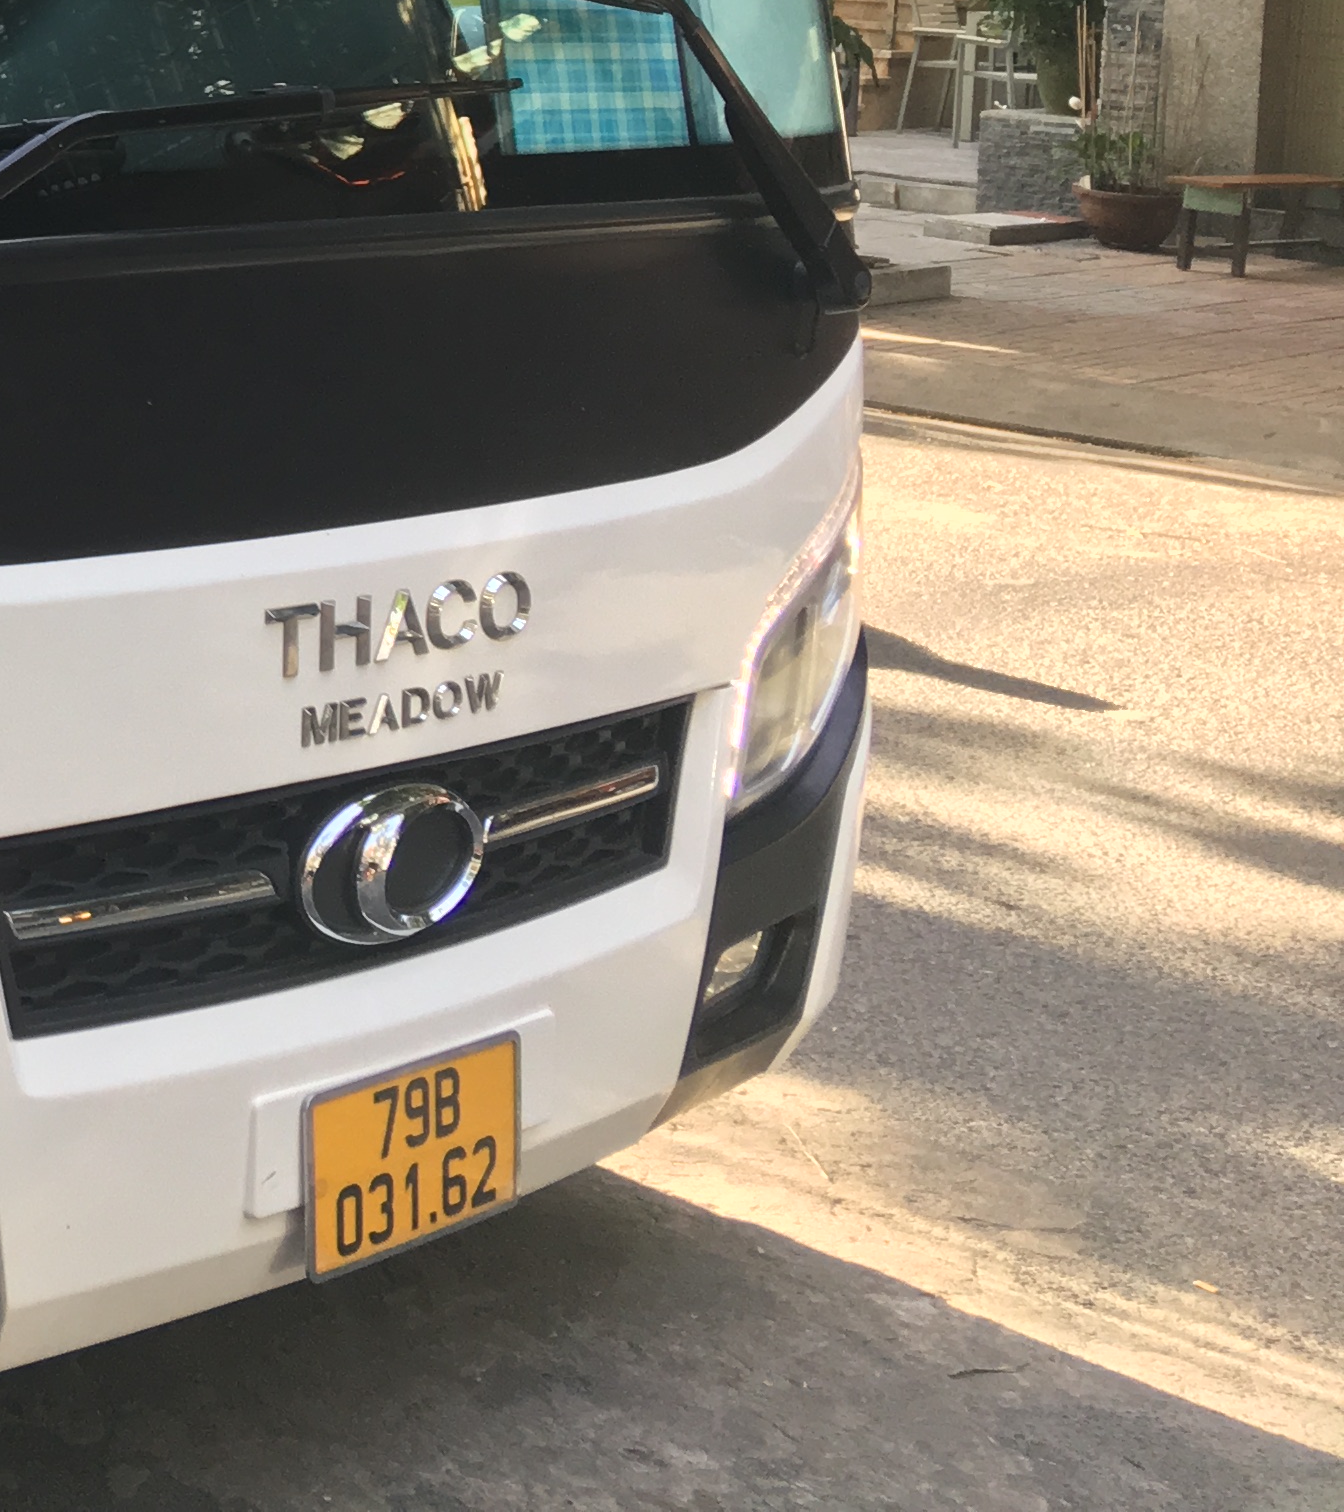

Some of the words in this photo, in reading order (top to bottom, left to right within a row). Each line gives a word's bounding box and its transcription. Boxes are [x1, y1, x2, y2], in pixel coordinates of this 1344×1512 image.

[264, 571, 532, 678] THACO
[301, 670, 505, 748] MEADOW
[374, 1066, 460, 1160] 79B
[336, 1135, 497, 1256] 031.62
